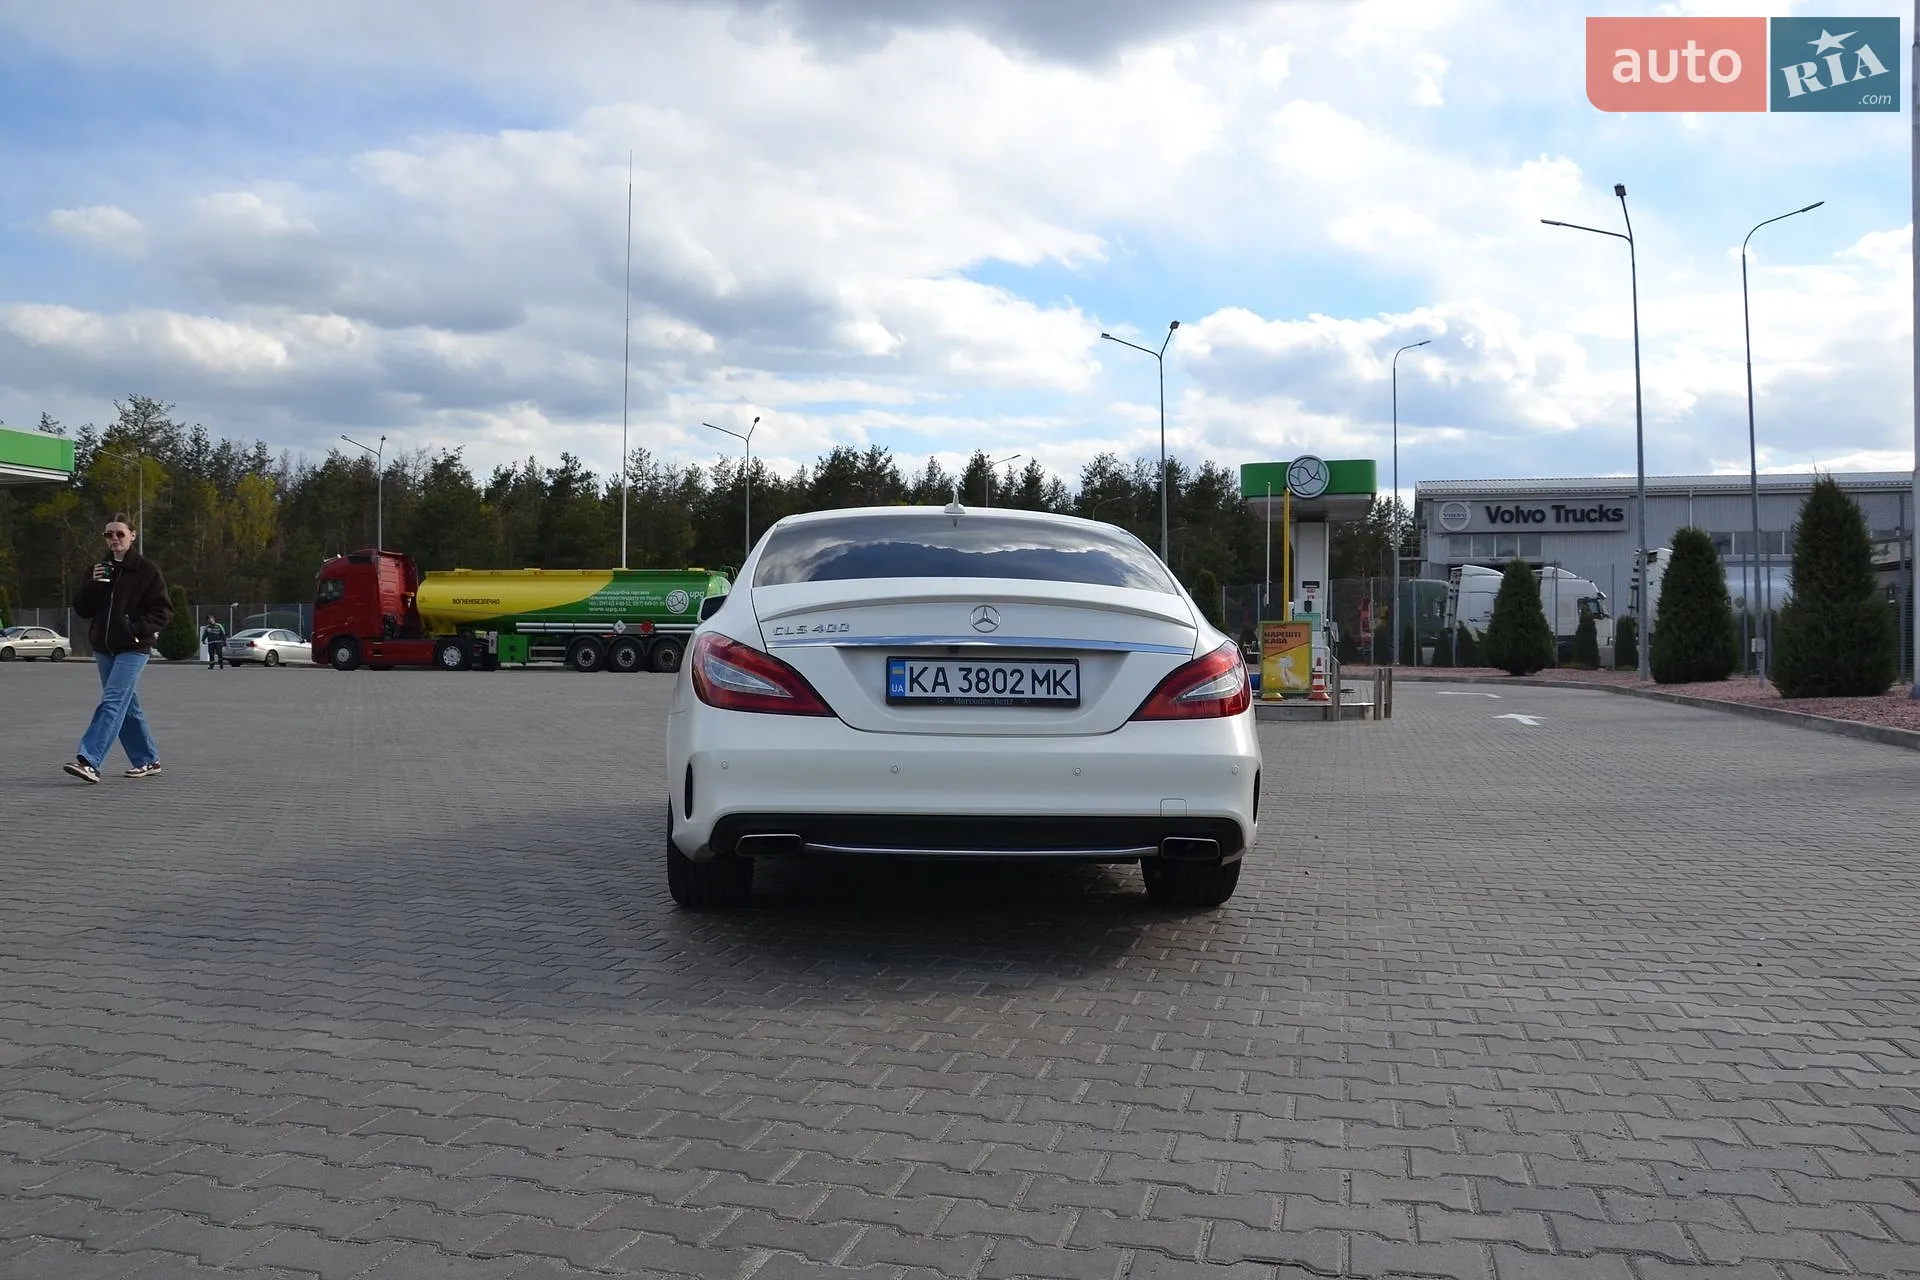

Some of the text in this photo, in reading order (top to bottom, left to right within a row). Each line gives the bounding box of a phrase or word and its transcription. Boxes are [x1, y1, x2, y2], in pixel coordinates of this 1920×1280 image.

[1485, 504, 1624, 524] Volvo Trucks
[689, 591, 705, 599] upg
[774, 622, 851, 636] CLS 400
[909, 666, 1072, 696] KA 3802 MK
[892, 684, 904, 692] UA
[953, 697, 1014, 706] Mercedes-Benz
